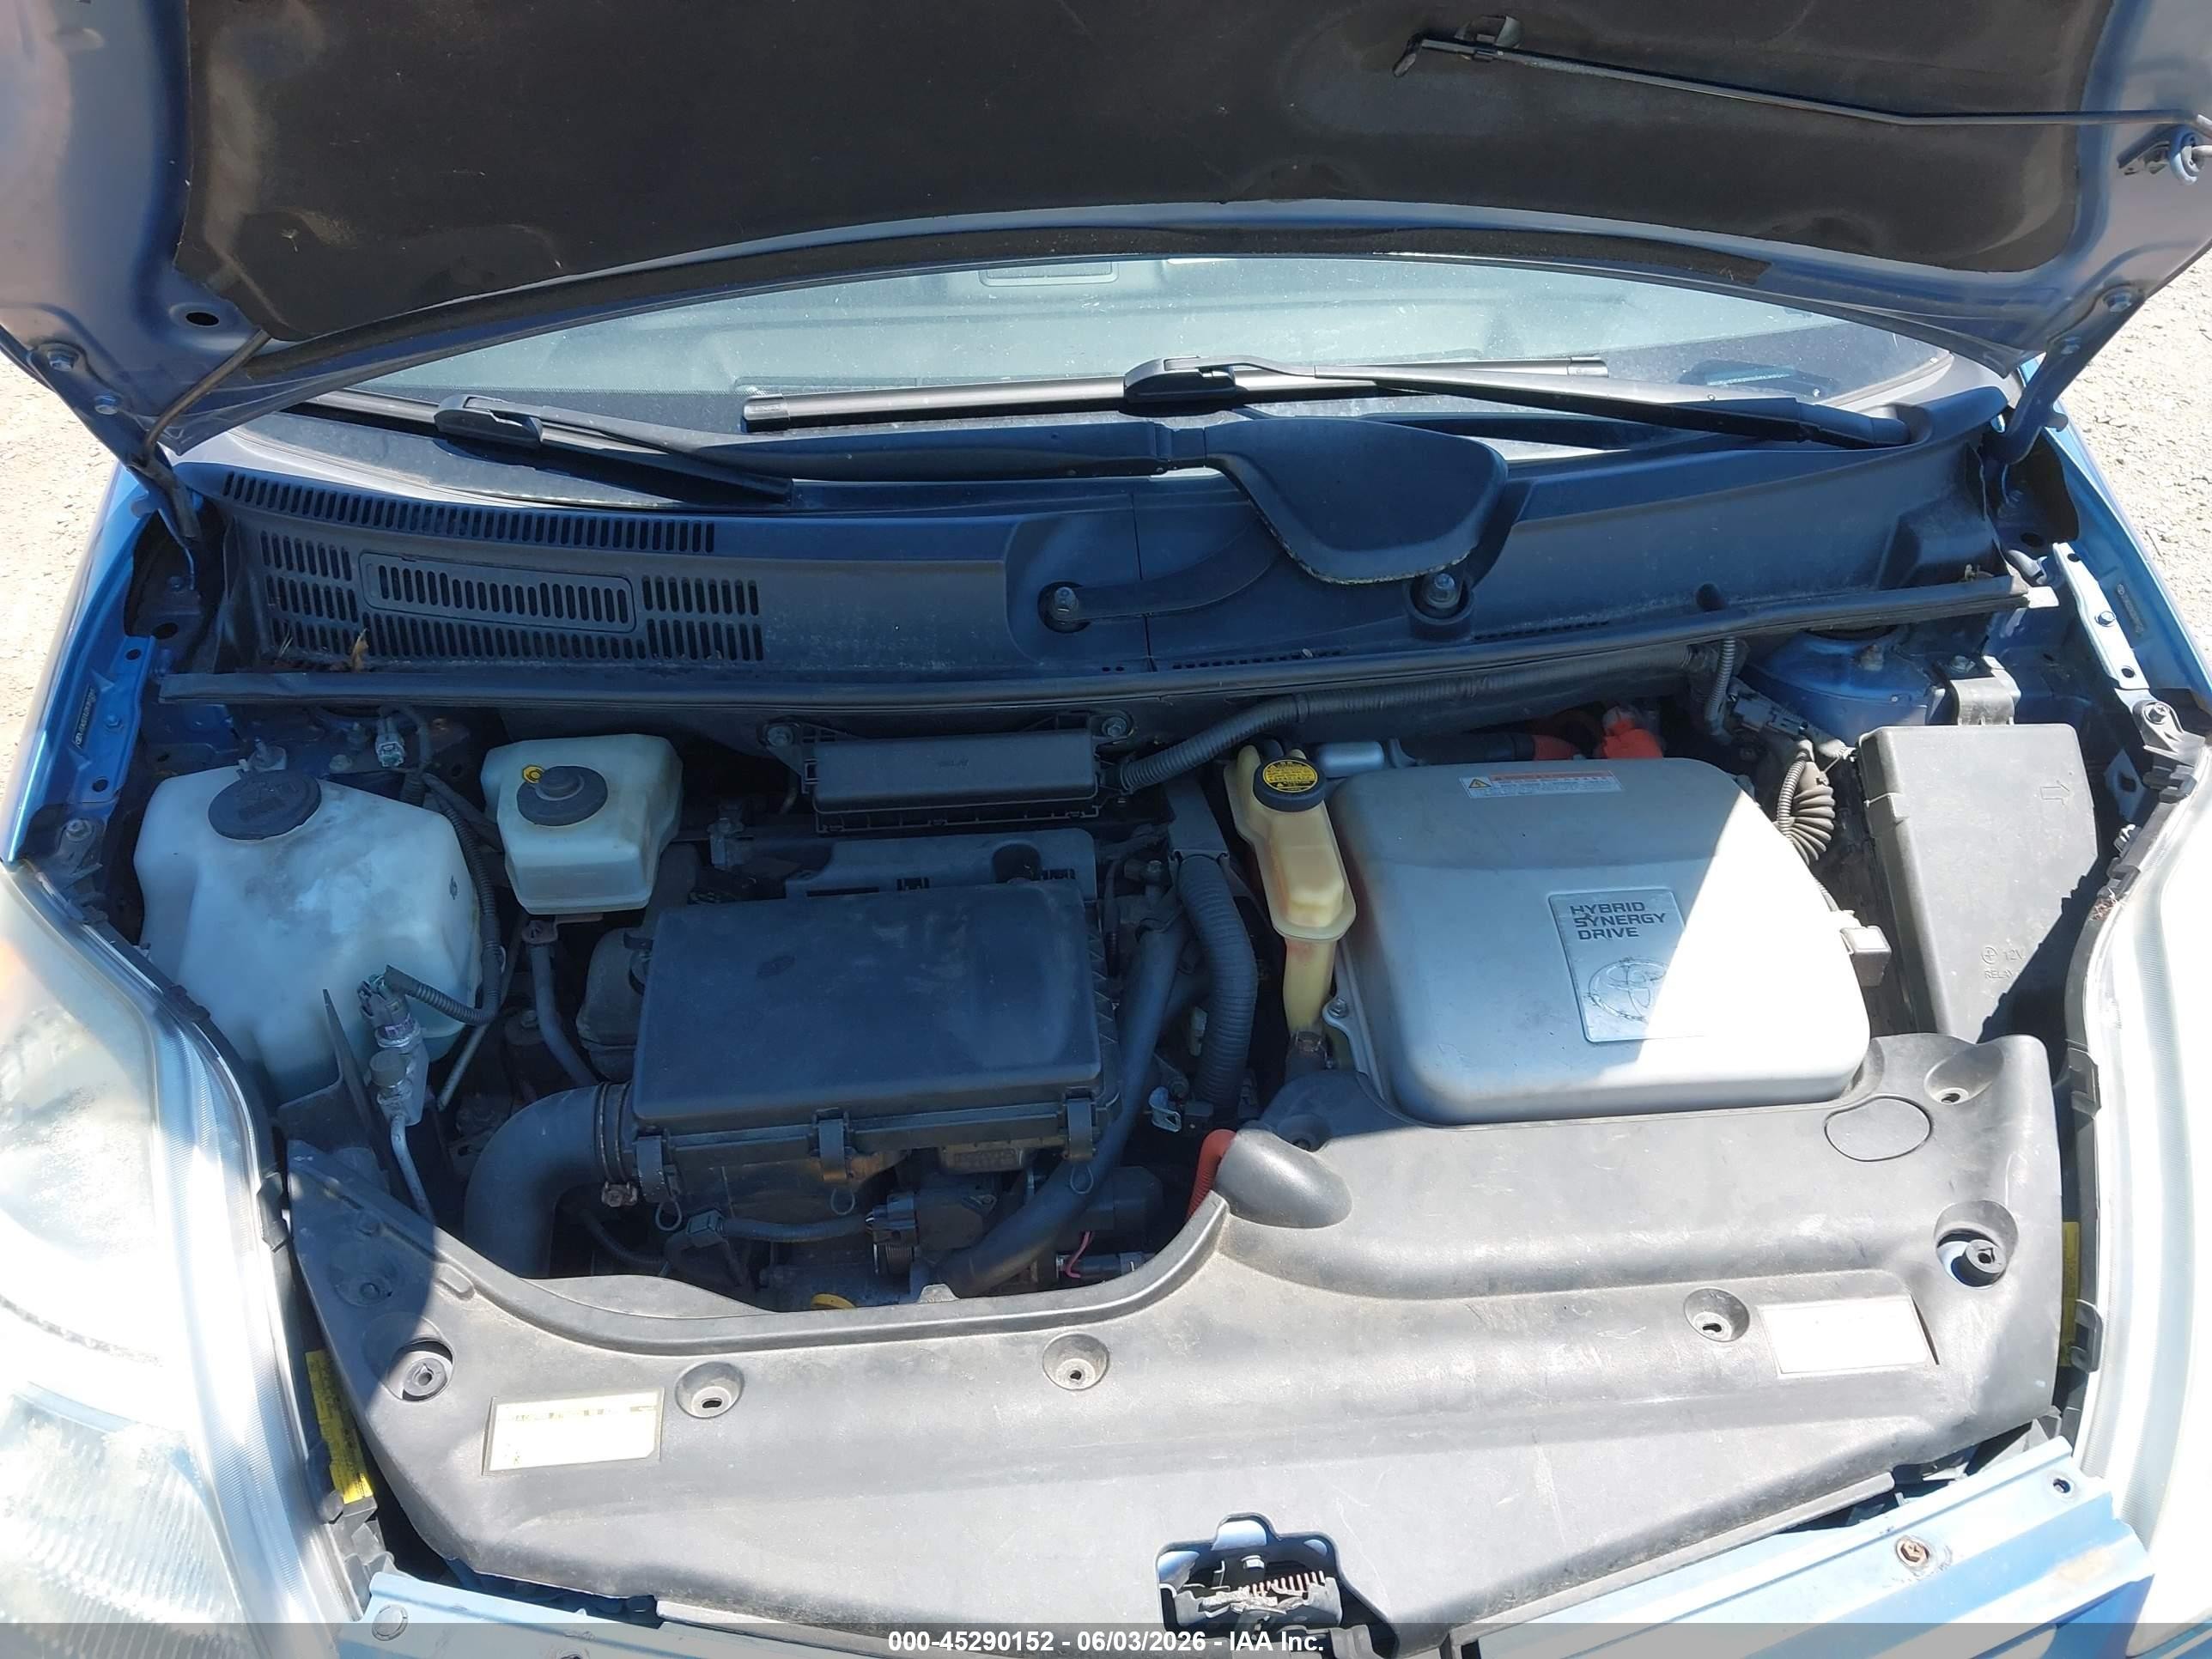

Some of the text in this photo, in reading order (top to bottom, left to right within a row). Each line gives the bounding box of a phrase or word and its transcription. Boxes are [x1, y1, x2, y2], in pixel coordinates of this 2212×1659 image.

[1569, 902, 1646, 915] HYBRID
[1573, 913, 1667, 928] SYNERGY
[1577, 927, 1640, 940] DRIVE
